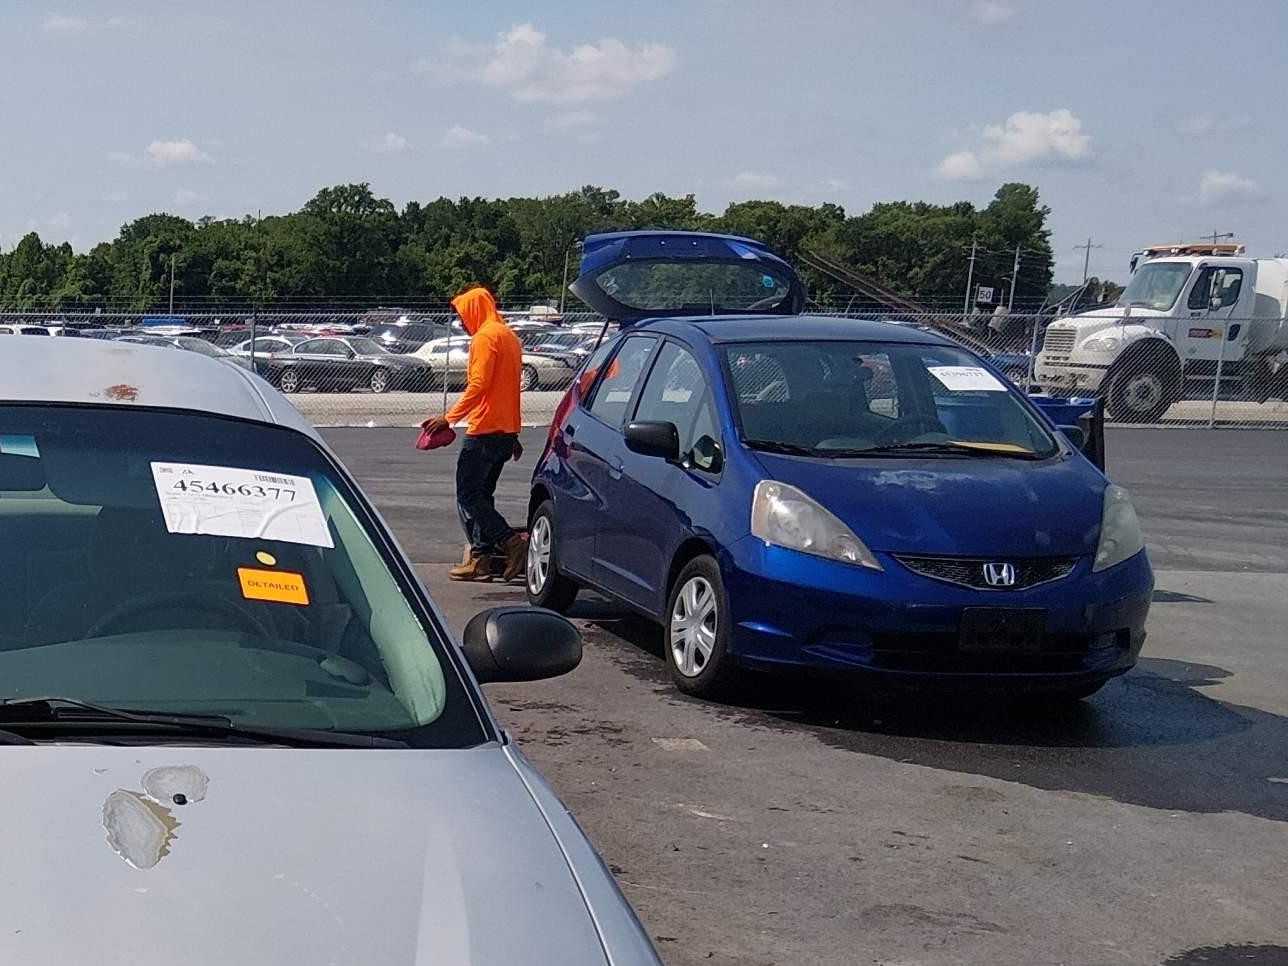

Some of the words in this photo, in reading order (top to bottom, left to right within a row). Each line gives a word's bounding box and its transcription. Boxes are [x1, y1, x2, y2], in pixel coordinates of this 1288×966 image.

[978, 290, 992, 300] 50
[173, 479, 297, 502] 45466377
[247, 580, 299, 591] DETAILED
